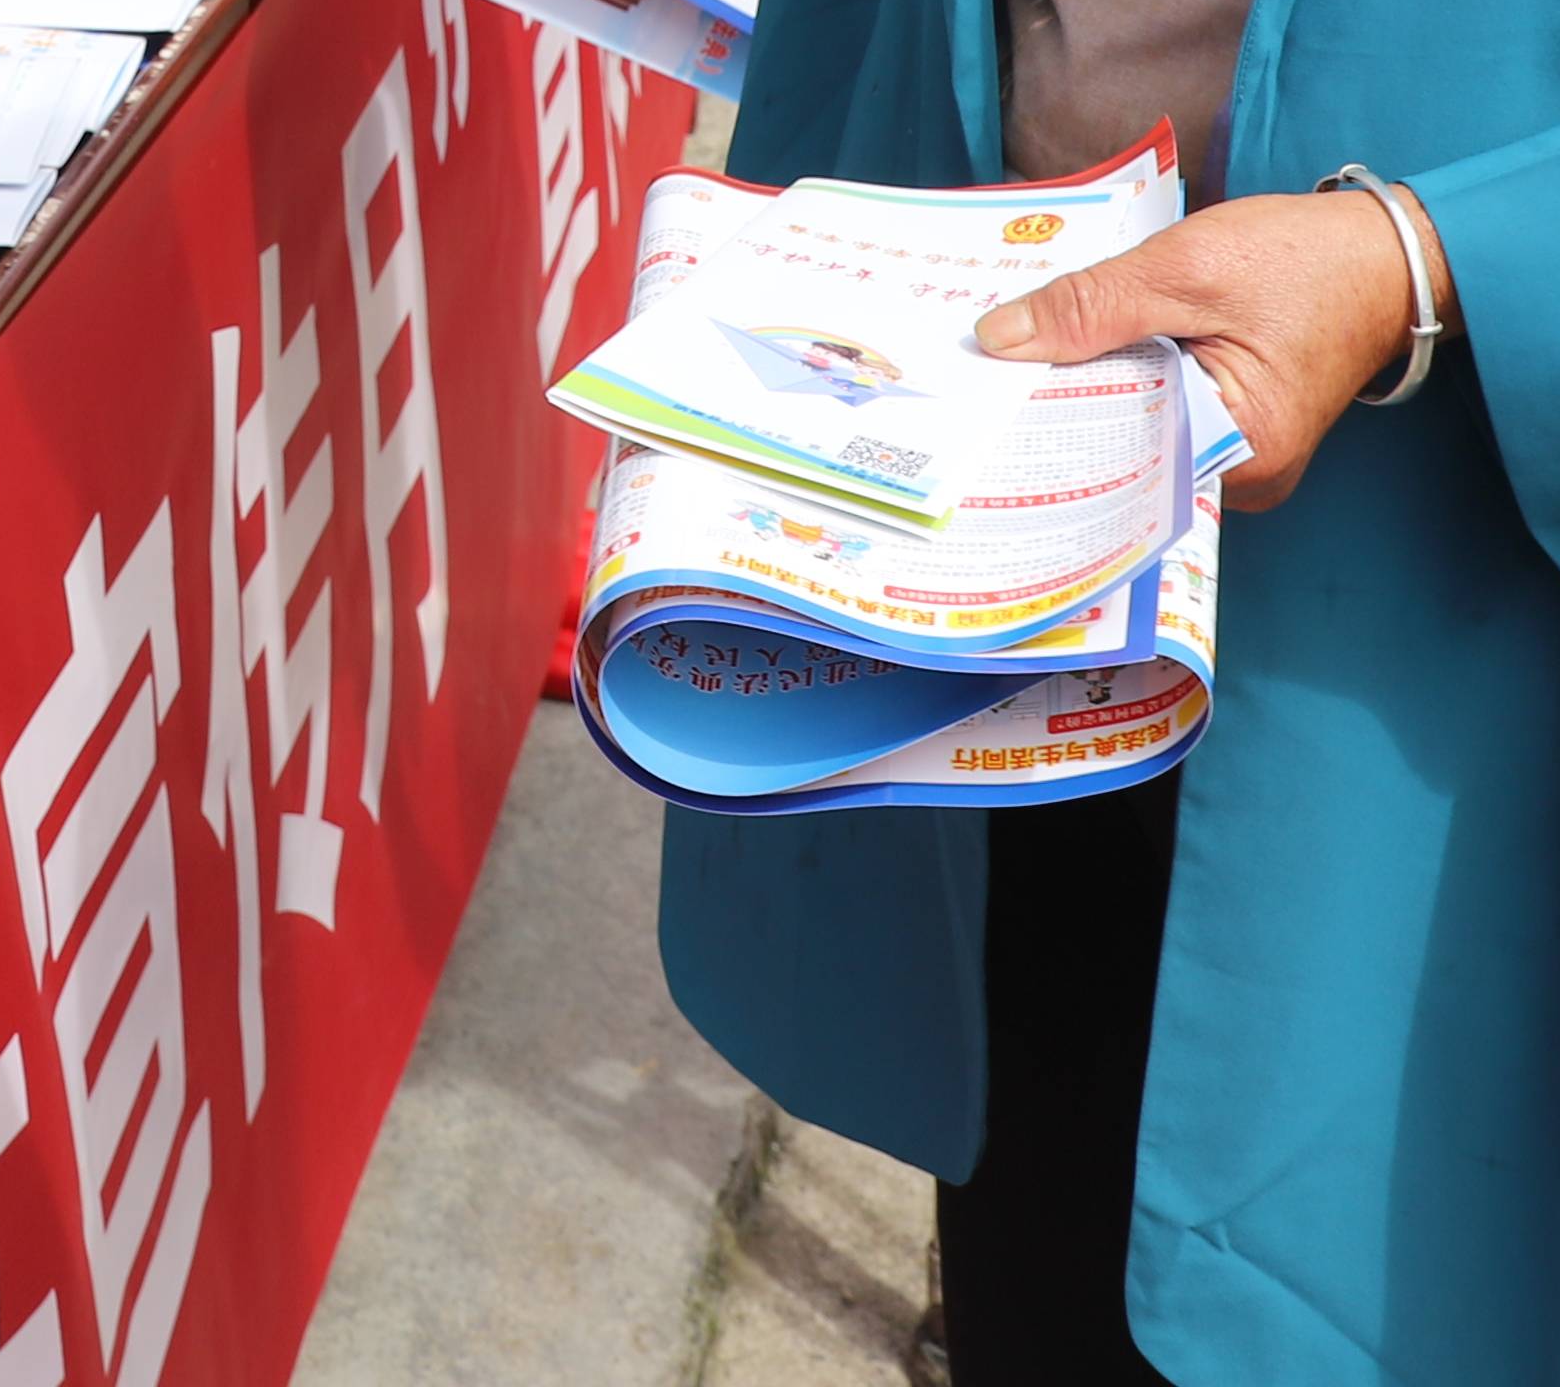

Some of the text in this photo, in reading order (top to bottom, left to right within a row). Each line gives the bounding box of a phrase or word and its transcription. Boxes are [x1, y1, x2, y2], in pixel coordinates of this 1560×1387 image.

[719, 549, 936, 626] 民法典与生活同行
[950, 715, 1171, 772] 民法典与生活同行
